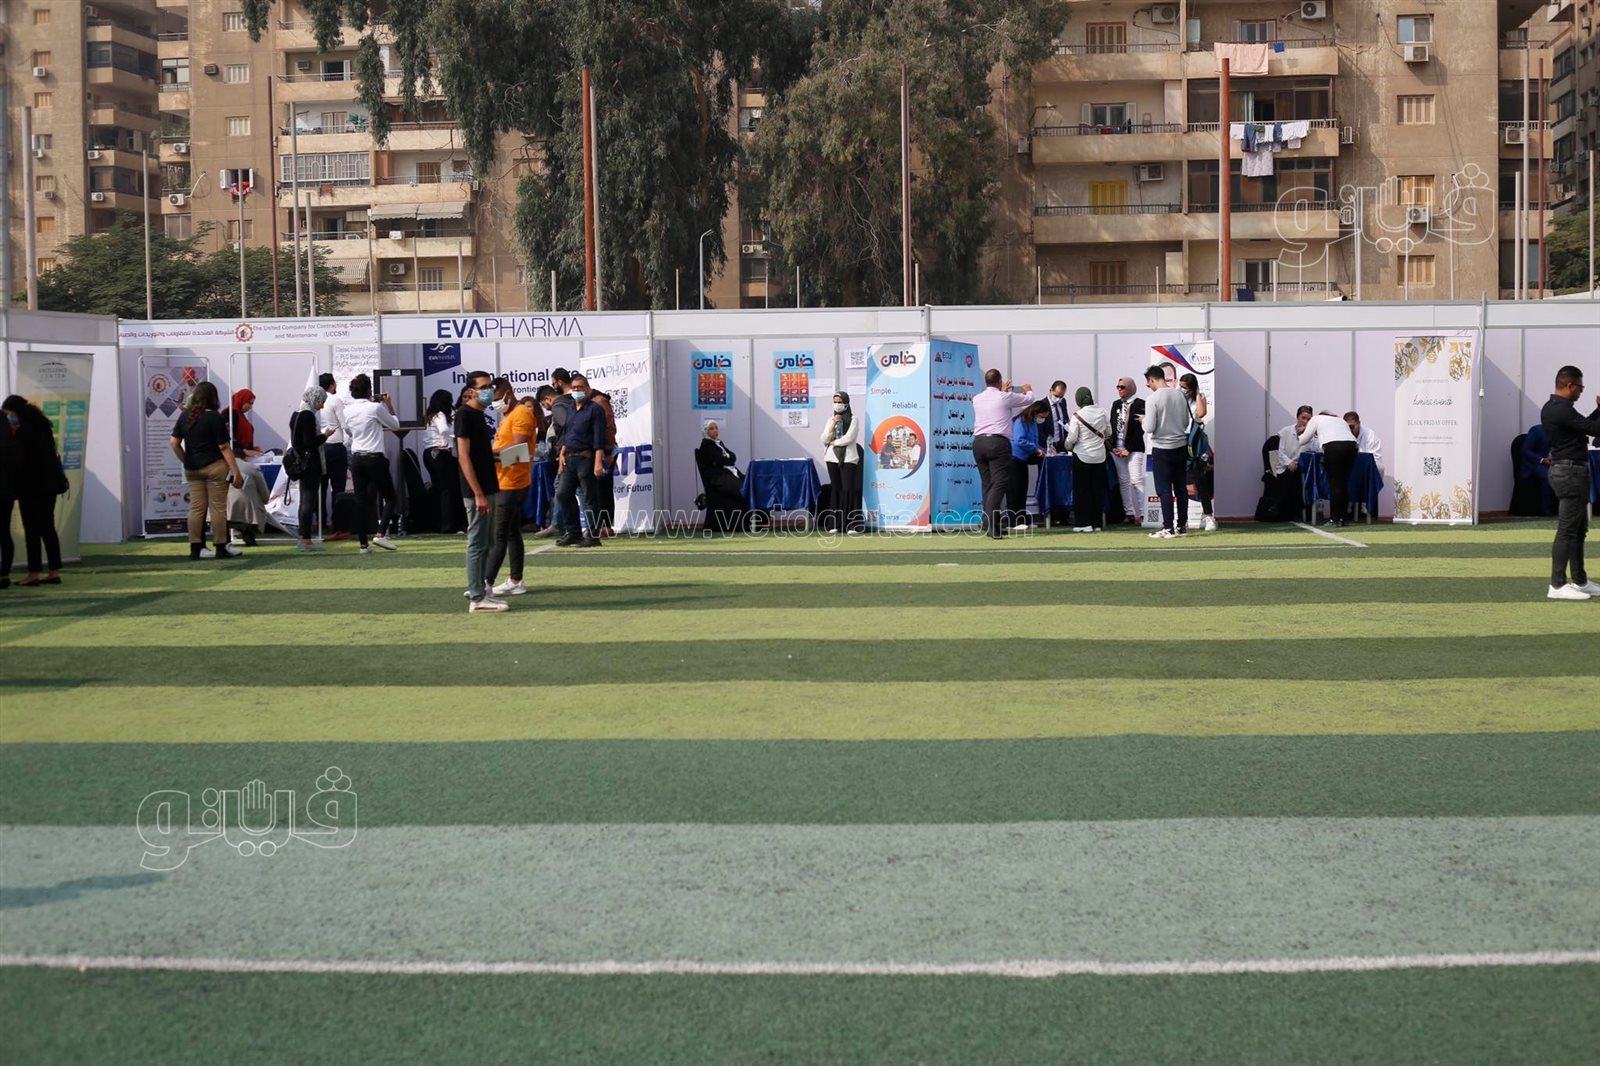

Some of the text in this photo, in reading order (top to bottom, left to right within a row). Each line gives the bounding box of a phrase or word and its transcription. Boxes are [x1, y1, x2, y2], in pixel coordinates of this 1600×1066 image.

[437, 317, 583, 338] EVAPHARMA
[693, 355, 731, 370] ضامن
[775, 354, 813, 369] ضامن
[881, 350, 917, 367] ضامن
[452, 368, 549, 384] Inational
[586, 361, 648, 380] EVAPHARMA
[870, 387, 892, 396] Simple
[892, 401, 918, 409] Reliable
[626, 484, 652, 493] Future
[896, 492, 923, 500] Credible
